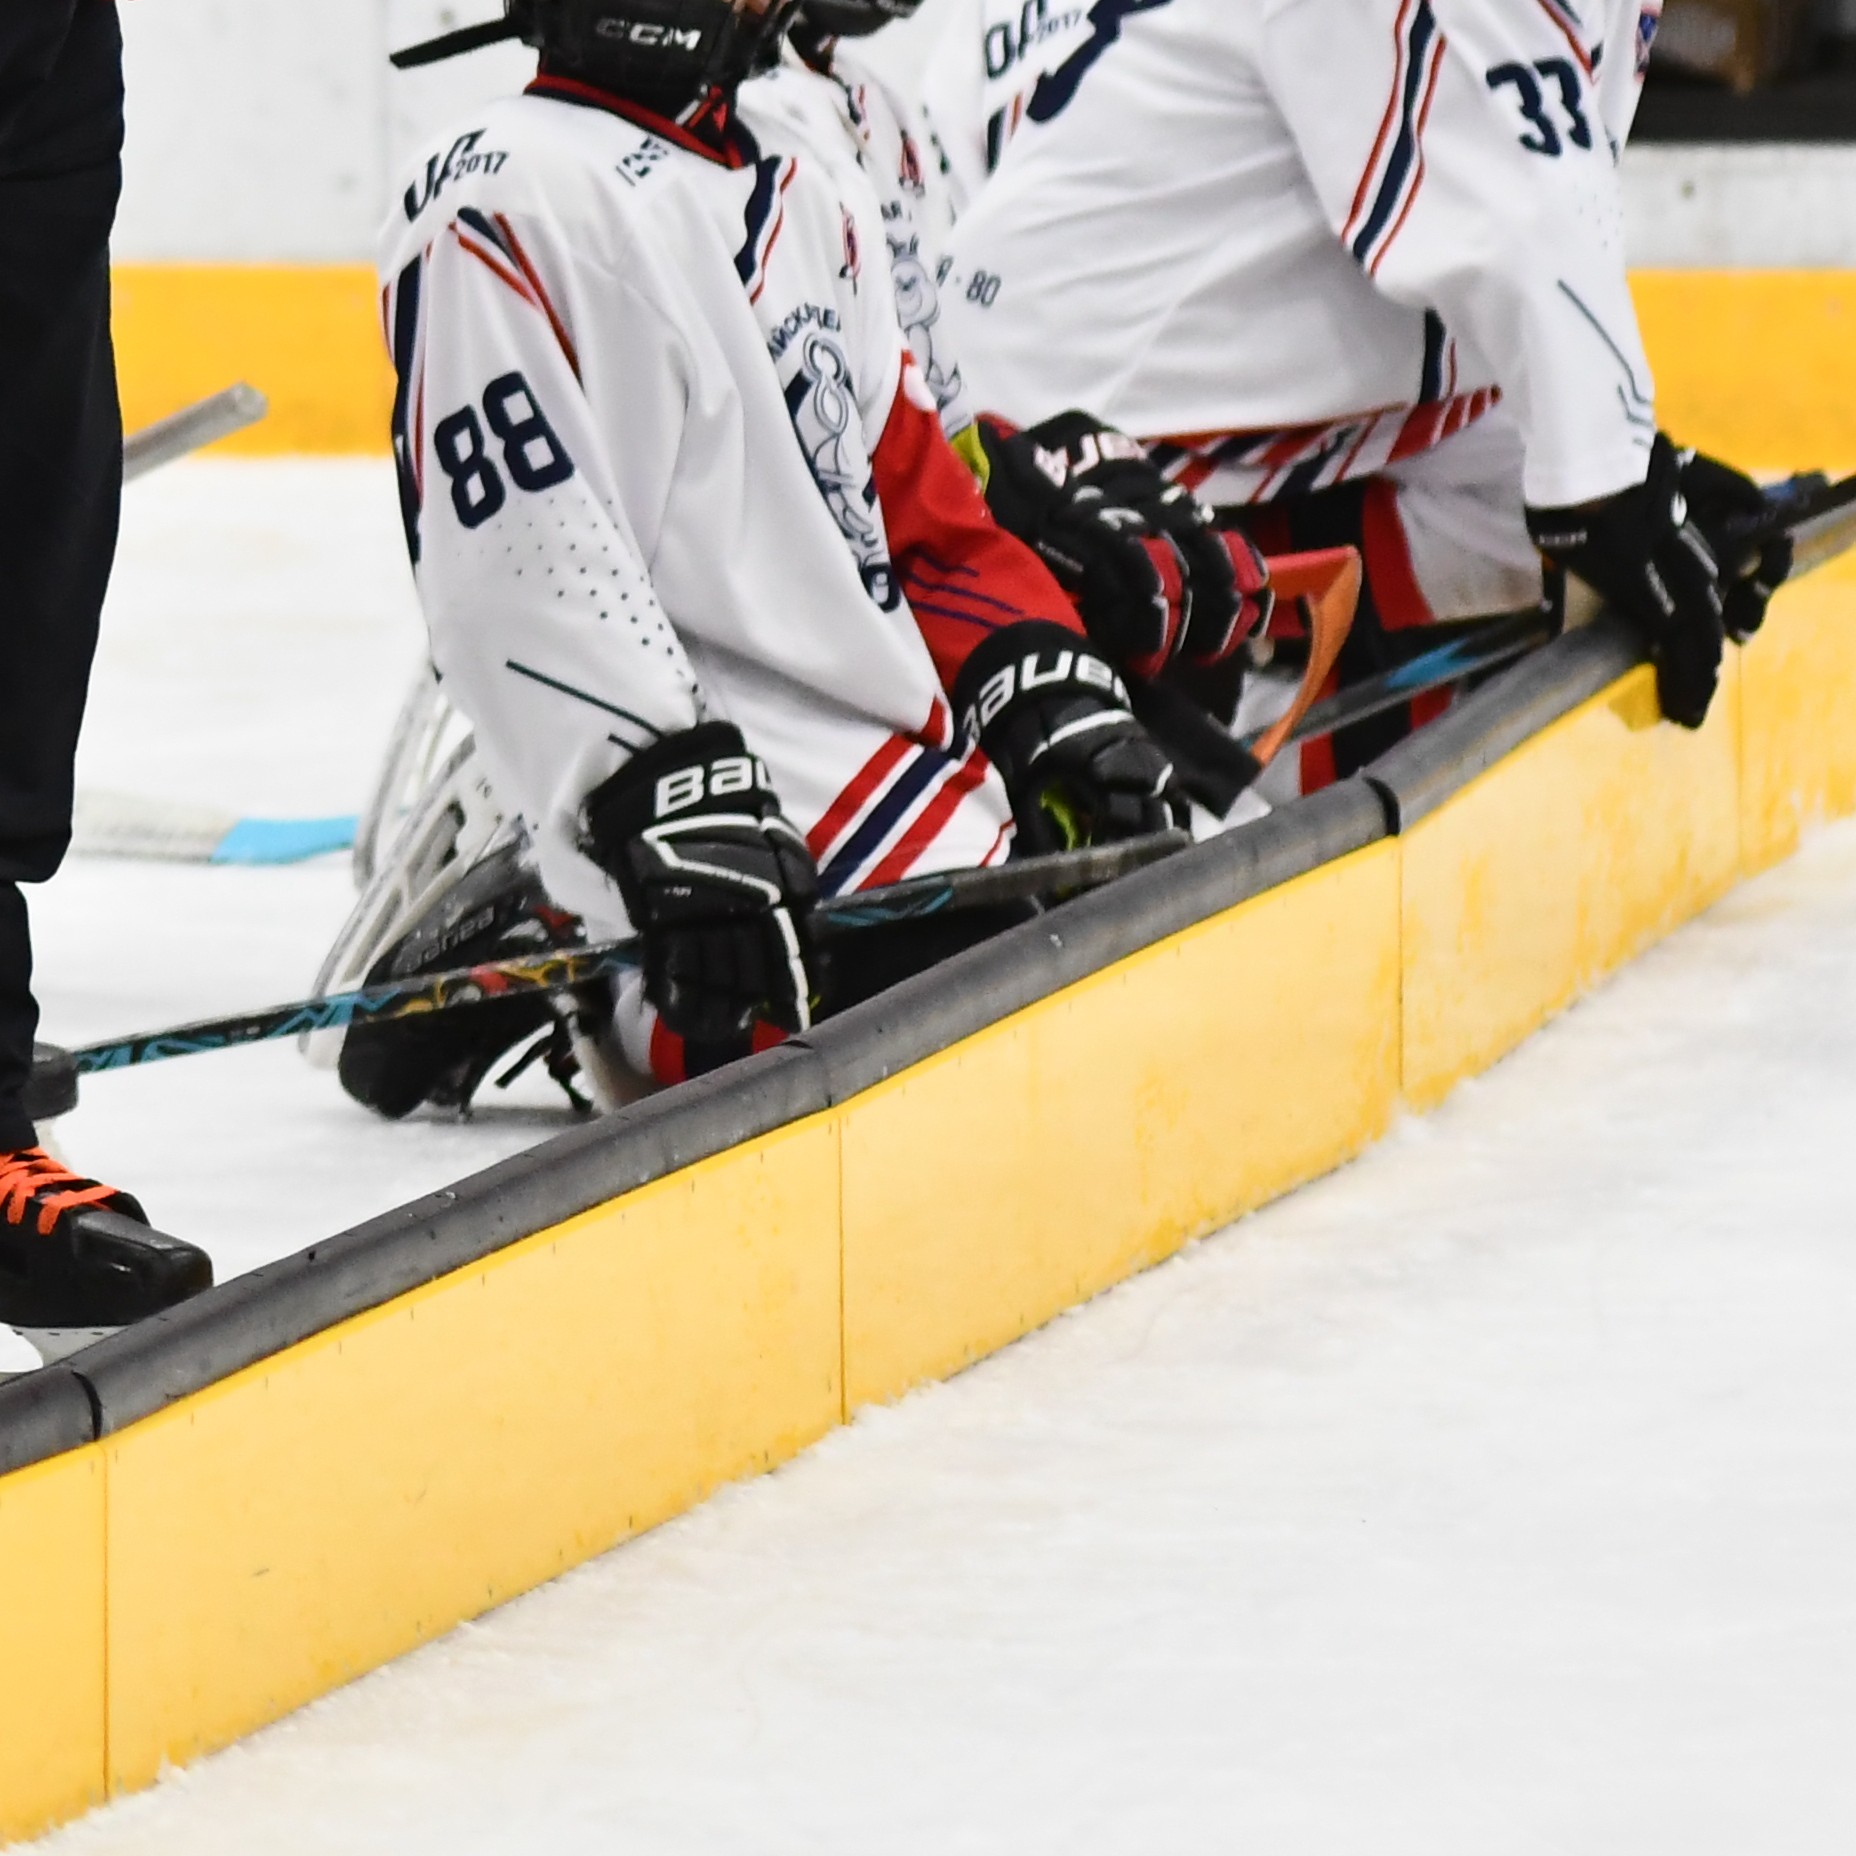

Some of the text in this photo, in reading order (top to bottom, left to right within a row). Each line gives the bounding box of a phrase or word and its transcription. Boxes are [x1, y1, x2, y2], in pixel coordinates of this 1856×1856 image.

[596, 16, 701, 51] CCM
[1486, 61, 1593, 157] 33
[432, 370, 575, 528] 88
